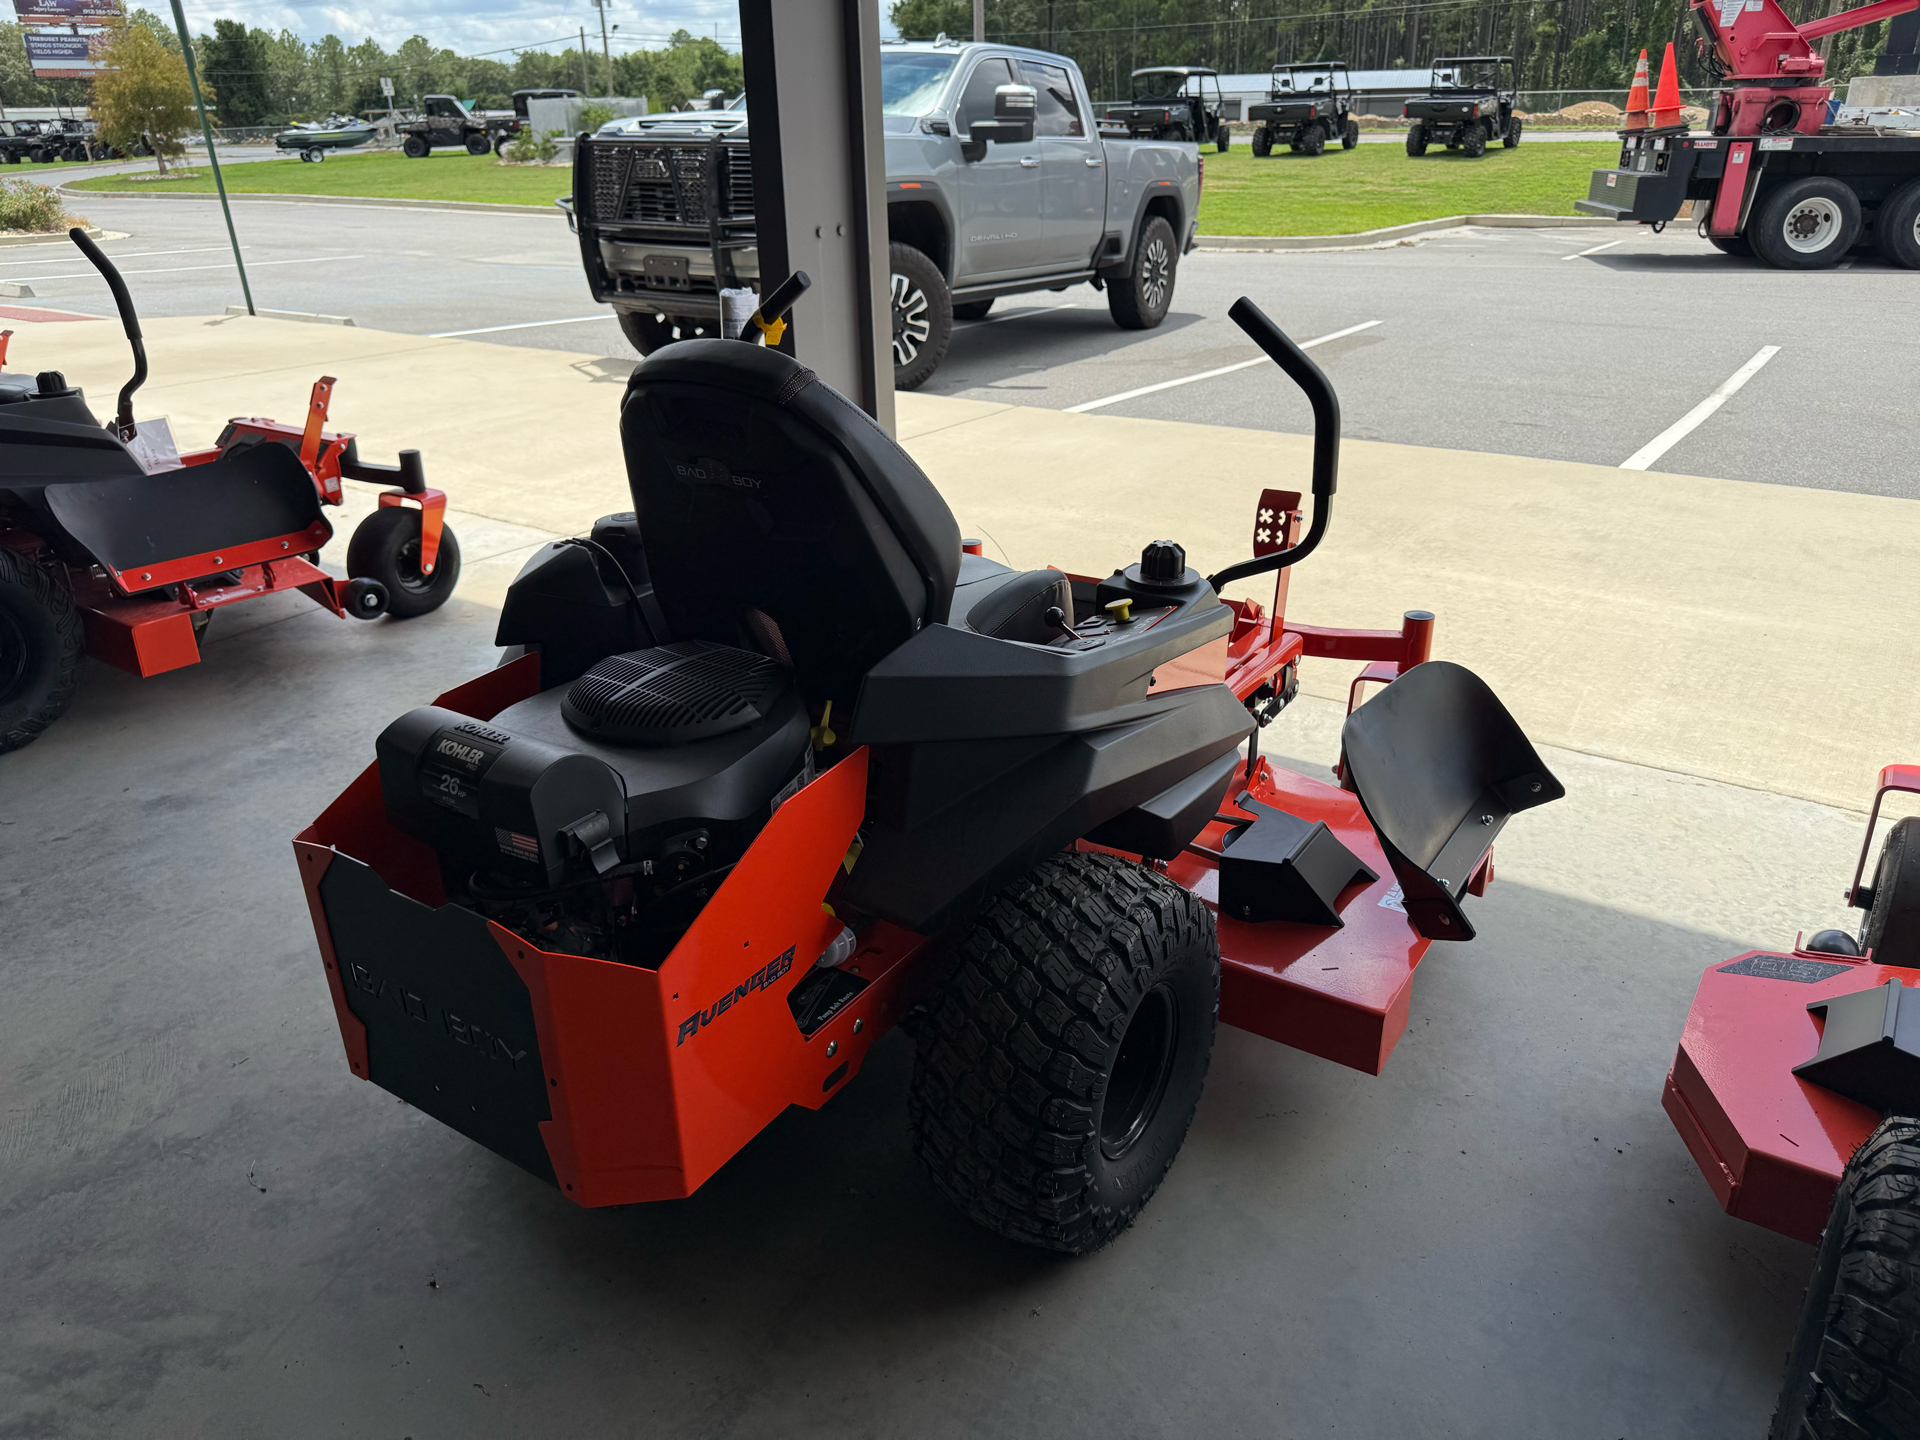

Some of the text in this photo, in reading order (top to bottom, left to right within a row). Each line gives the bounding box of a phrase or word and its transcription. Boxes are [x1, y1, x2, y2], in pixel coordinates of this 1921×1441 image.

[676, 465, 762, 489] BAD BOY
[454, 721, 512, 745] KOHLER
[437, 738, 485, 765] KOHLER
[465, 763, 478, 771] PRO
[439, 774, 467, 799] 26 HP
[762, 965, 791, 988] BAD BOY
[676, 943, 797, 1048] AVENGER
[351, 962, 527, 1071] BAD BOY
[817, 1009, 834, 1021] Pump
